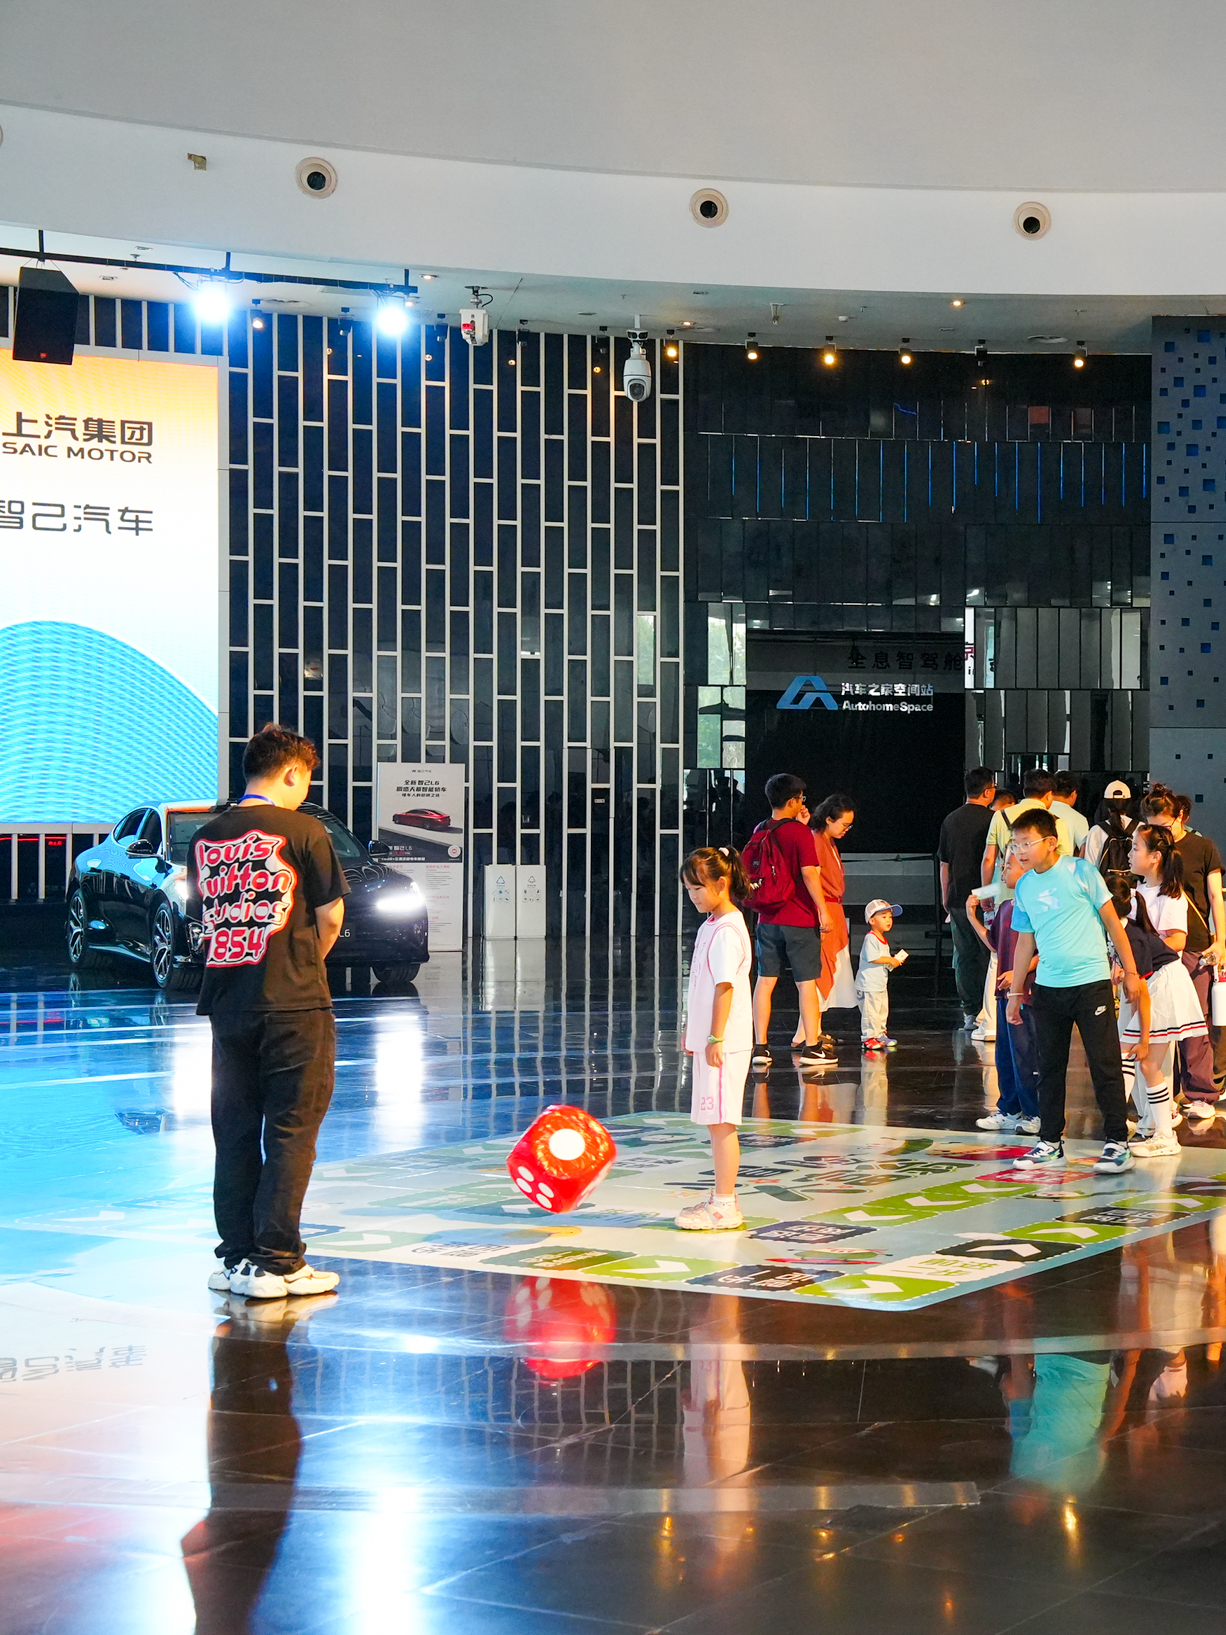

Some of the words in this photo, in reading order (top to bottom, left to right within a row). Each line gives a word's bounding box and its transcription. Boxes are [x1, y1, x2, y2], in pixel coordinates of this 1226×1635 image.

[2, 411, 153, 447] 上汽集团
[1, 441, 58, 458] SAIC
[67, 446, 153, 464] MOTOR
[0, 500, 153, 536] 智己汽车
[841, 682, 934, 697] 汽车之家空间站
[213, 927, 264, 961] 854
[701, 1096, 715, 1111] 23
